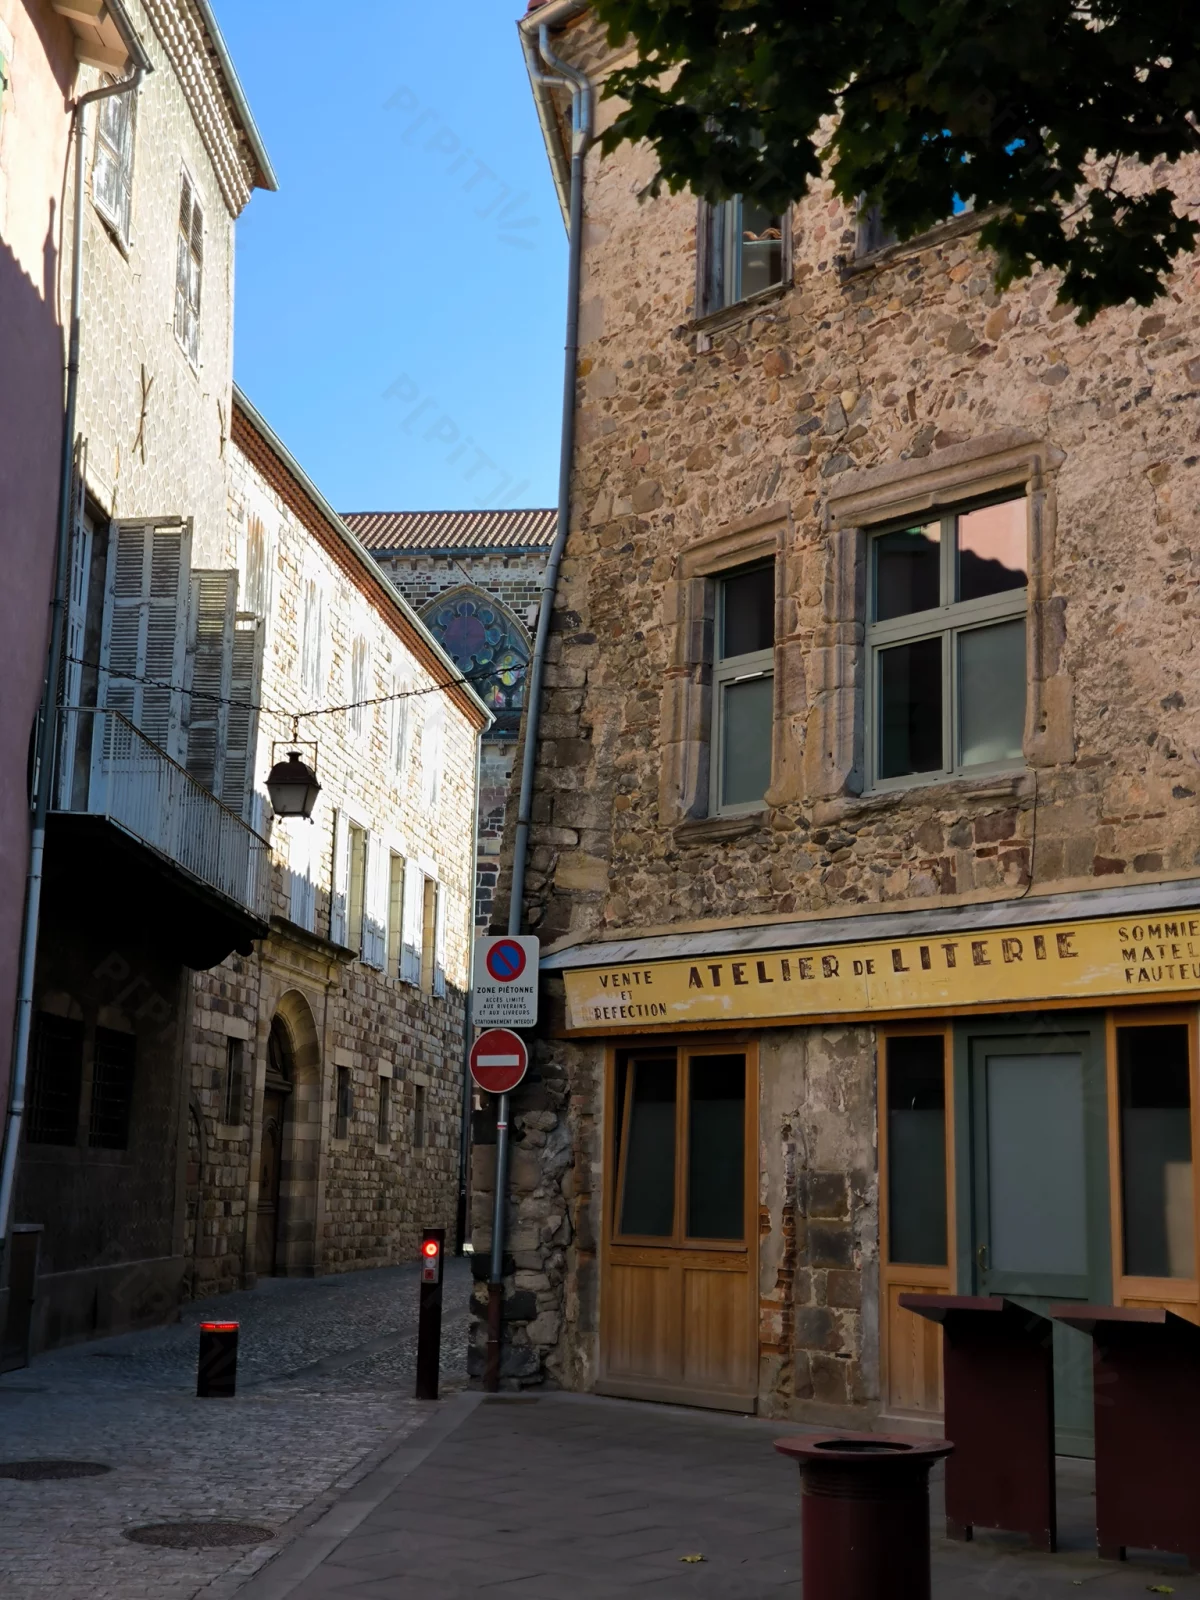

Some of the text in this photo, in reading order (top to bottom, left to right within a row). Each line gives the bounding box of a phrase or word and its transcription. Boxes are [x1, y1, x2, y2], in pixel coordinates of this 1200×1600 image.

[1118, 920, 1200, 942] SOMMIE
[688, 931, 1079, 989] ATELIER DE LITERIE
[1122, 942, 1200, 962] MATEL
[599, 971, 653, 988] VENTE
[498, 986, 534, 994] PIÉTONNE
[621, 990, 633, 1001] ET
[594, 1003, 667, 1020] REFECTION
